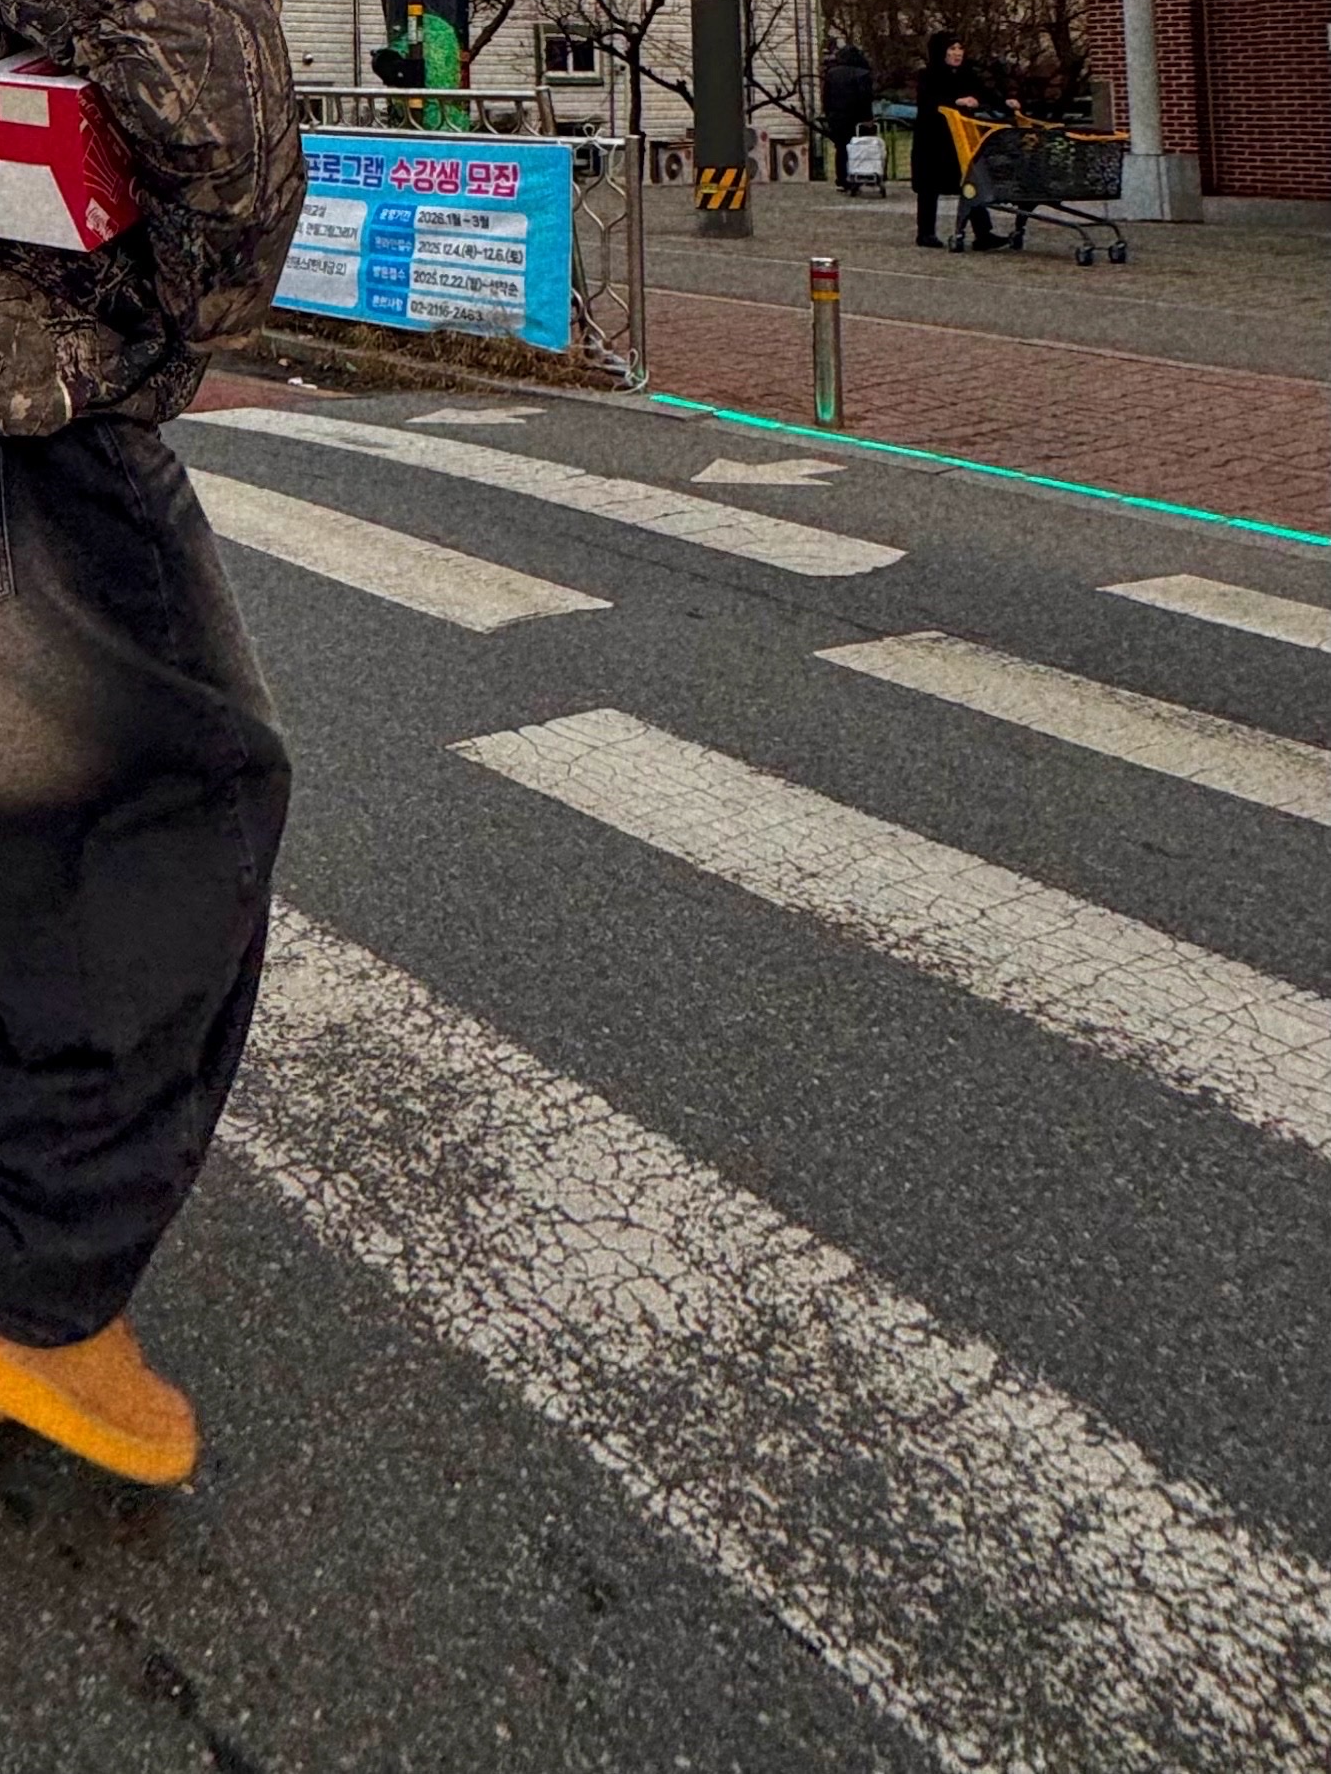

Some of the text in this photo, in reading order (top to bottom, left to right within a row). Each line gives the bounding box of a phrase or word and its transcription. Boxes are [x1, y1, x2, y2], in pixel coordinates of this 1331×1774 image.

[304, 152, 519, 198] 프로그램 수강생 모집
[472, 214, 490, 229] 3월
